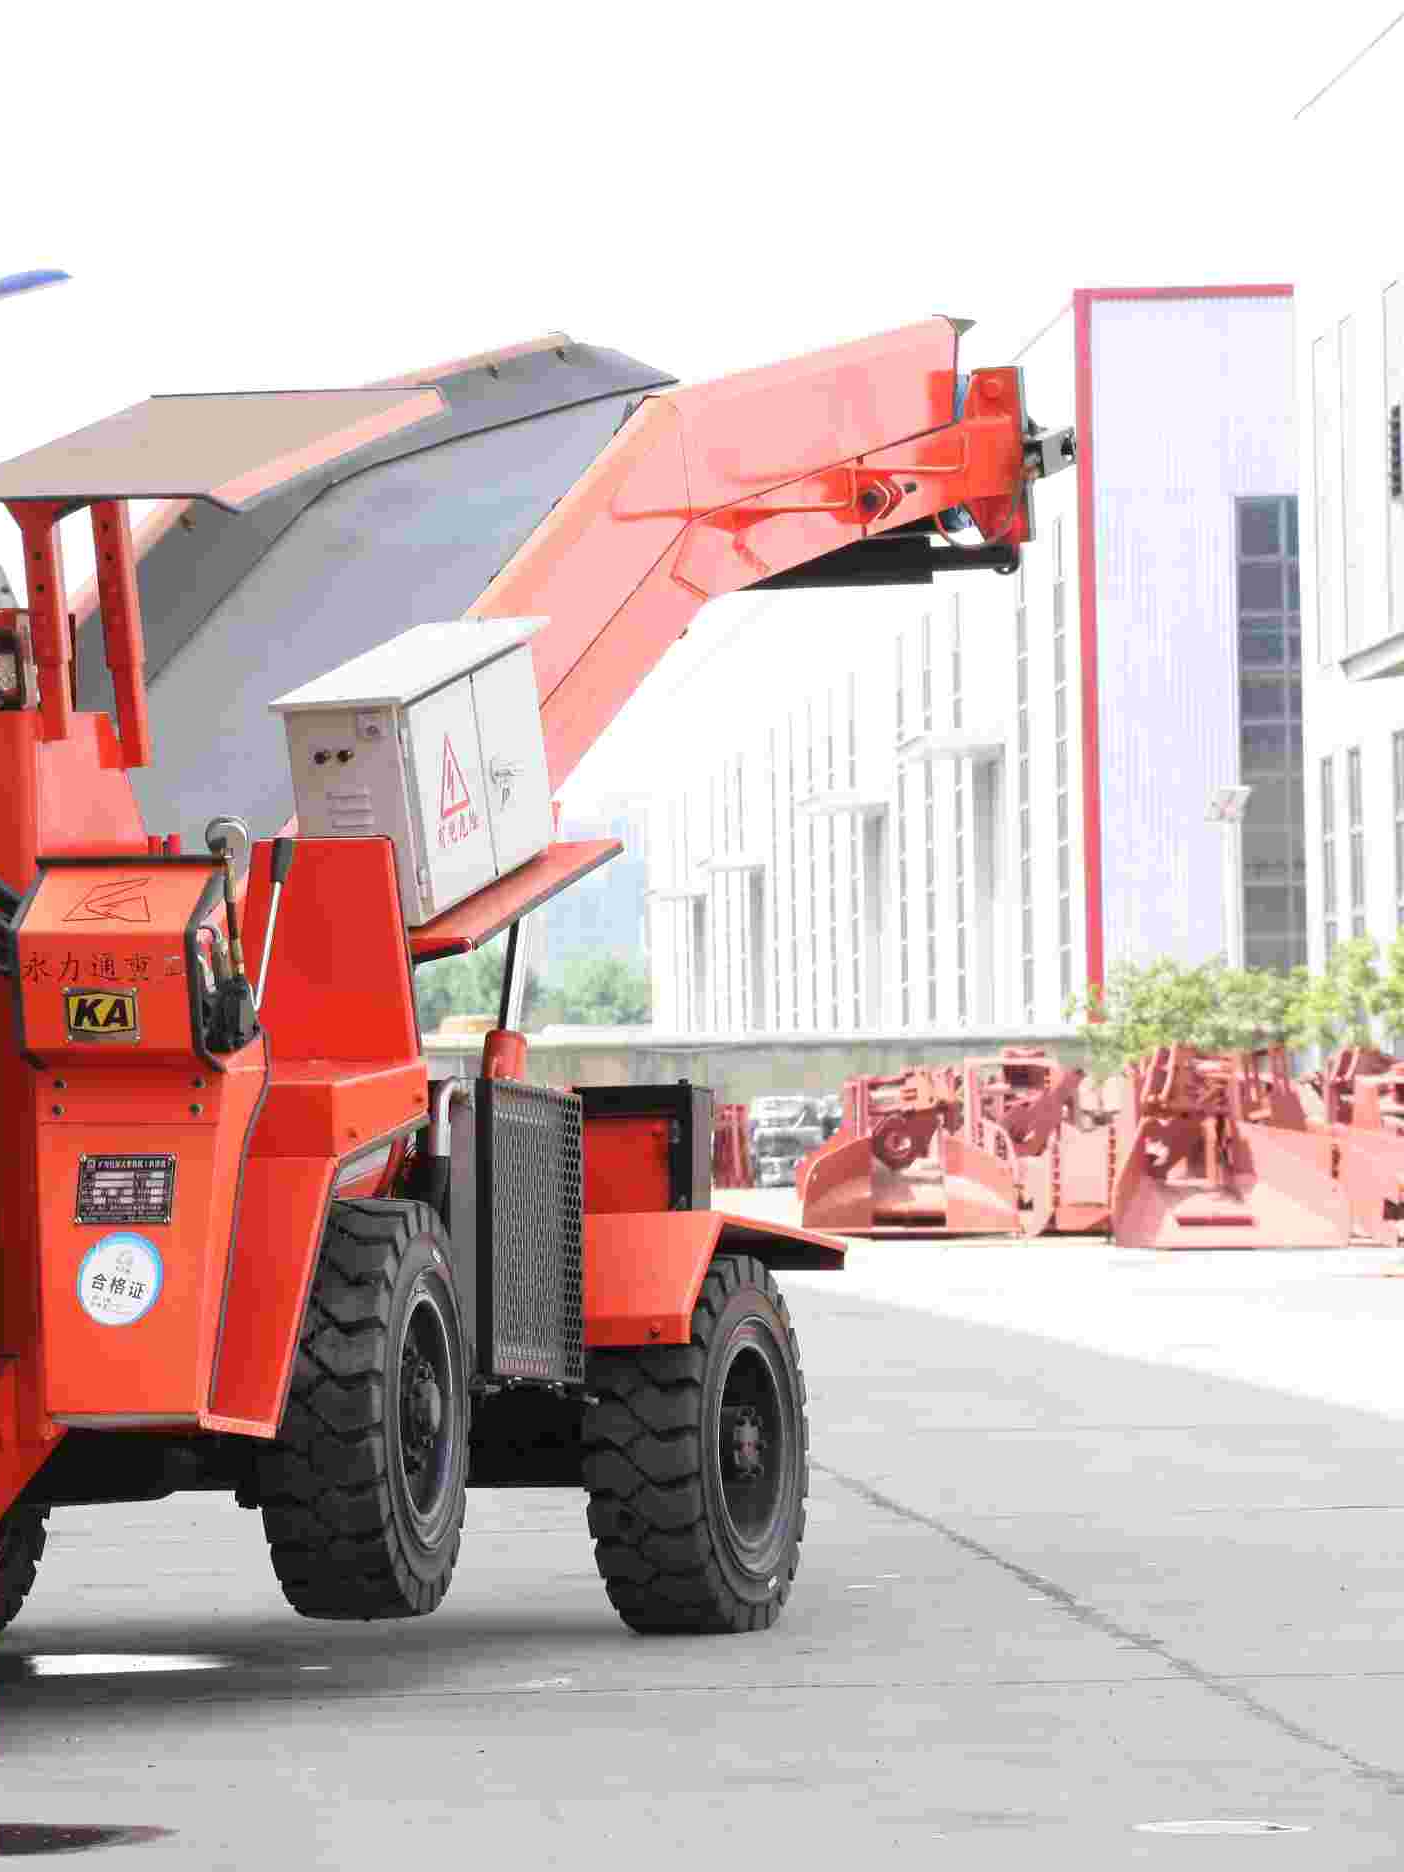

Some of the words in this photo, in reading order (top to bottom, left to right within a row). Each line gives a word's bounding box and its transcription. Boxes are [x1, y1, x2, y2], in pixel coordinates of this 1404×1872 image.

[73, 998, 129, 1028] KA
[91, 1273, 147, 1299] 合格证
